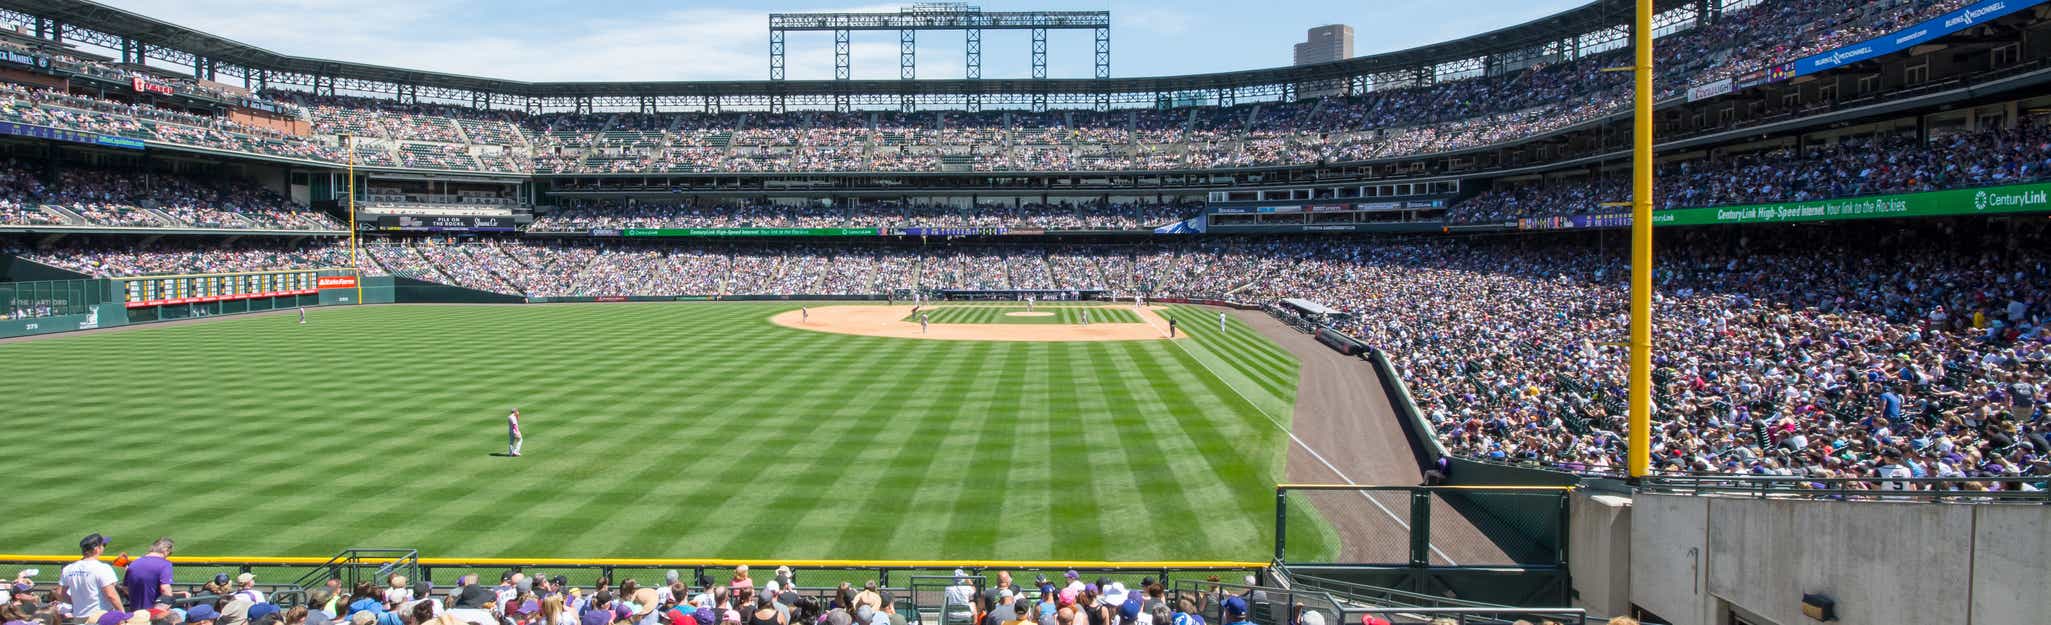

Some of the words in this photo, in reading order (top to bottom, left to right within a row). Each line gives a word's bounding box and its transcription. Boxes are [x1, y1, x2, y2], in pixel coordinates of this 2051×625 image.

[1989, 190, 2047, 207] CenturyLink
[1717, 206, 1757, 221] CenturyLink
[1758, 205, 1800, 220] High-Speed
[1801, 205, 1824, 217] Internet
[1826, 204, 1840, 215] Your
[1841, 203, 1853, 214] link
[1854, 202, 1862, 213] to
[1863, 201, 1874, 213] the
[1876, 199, 1907, 213] Rockies.
